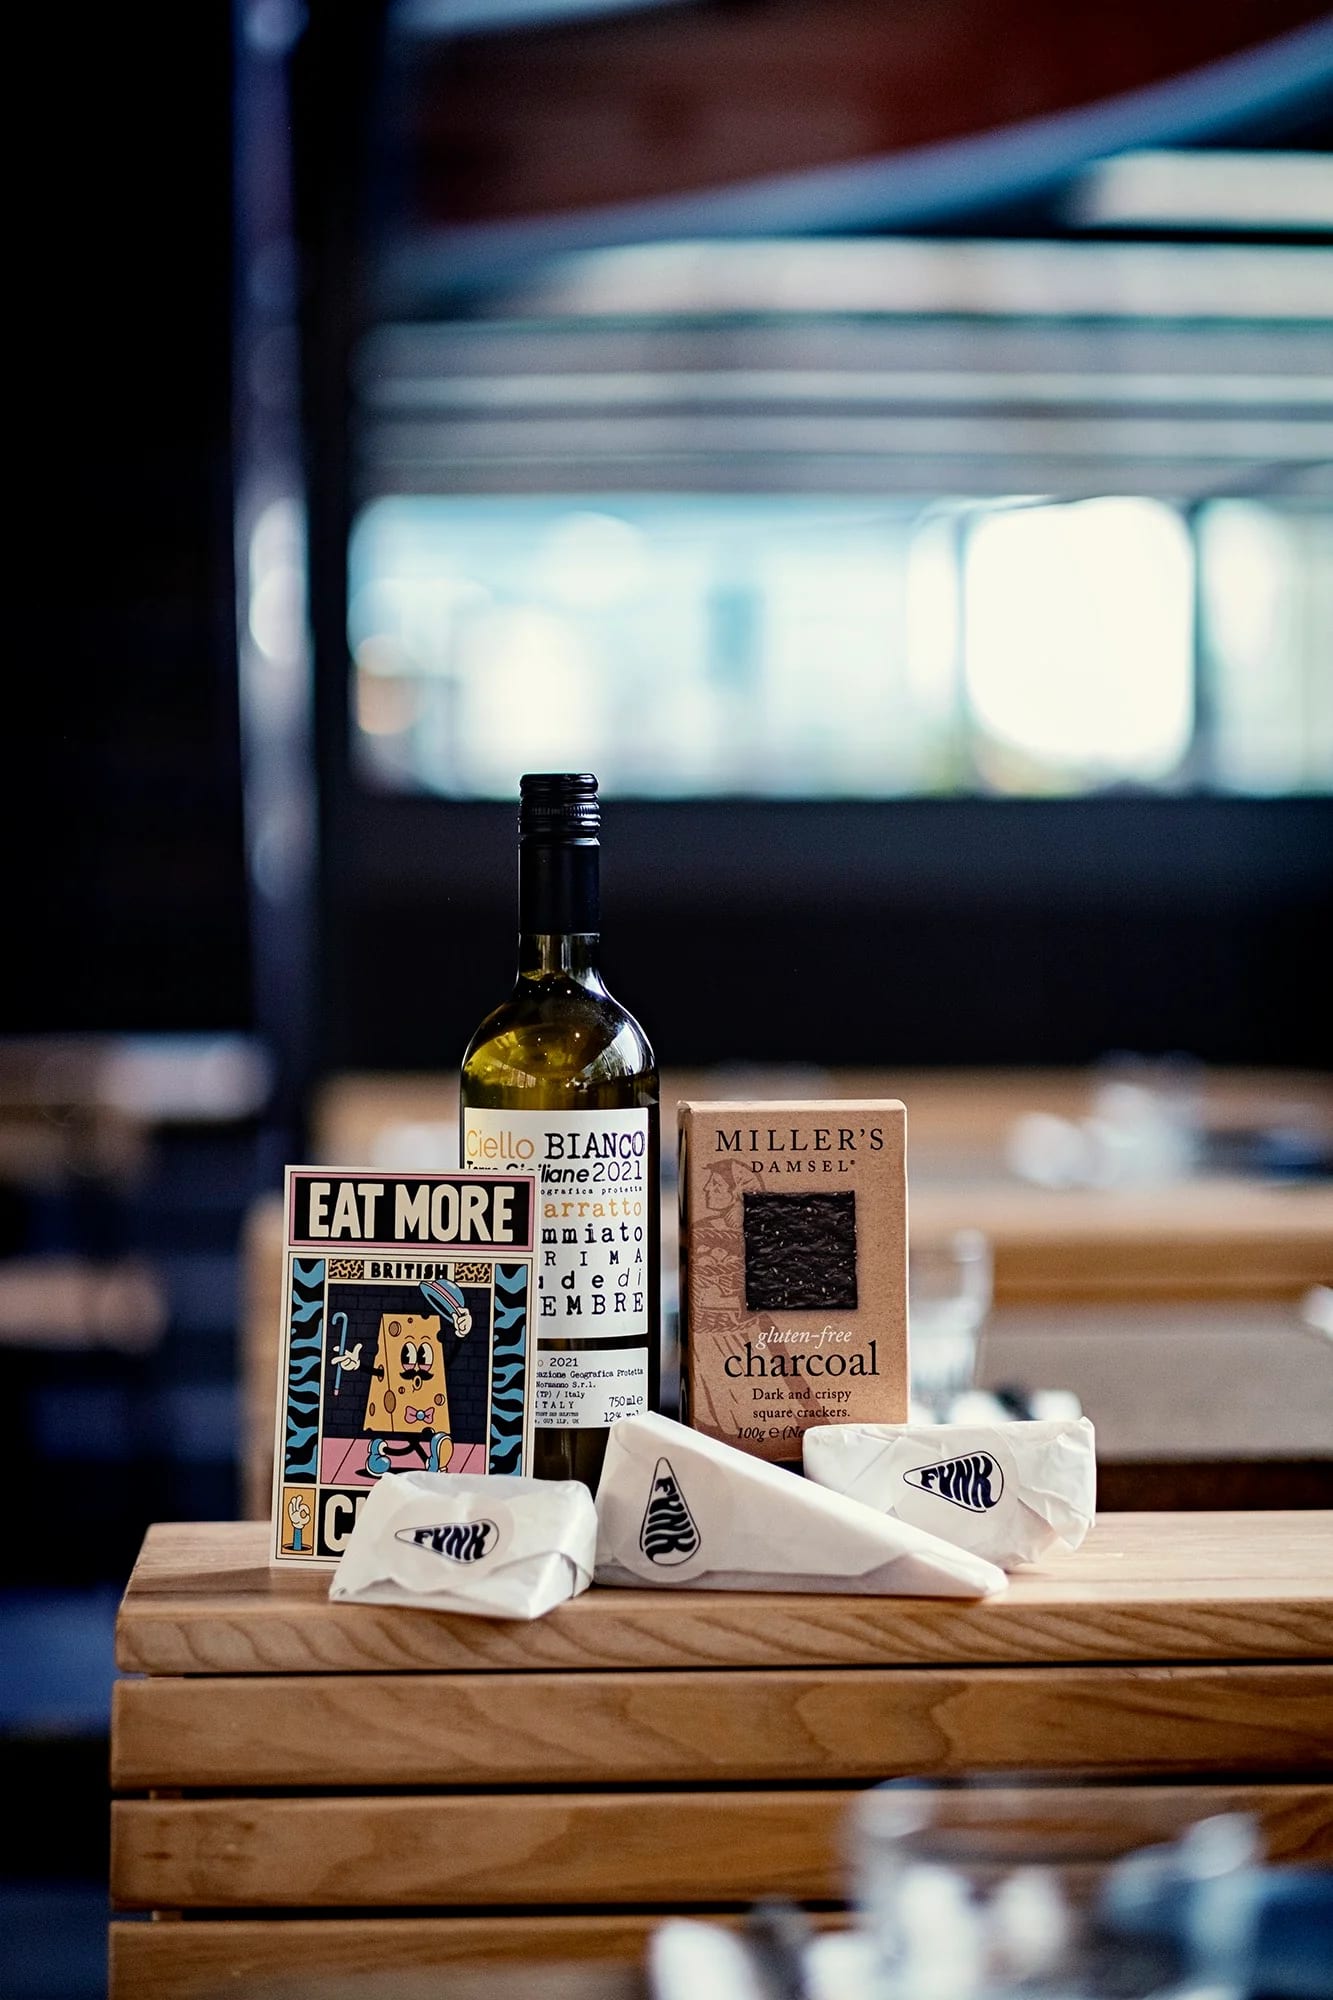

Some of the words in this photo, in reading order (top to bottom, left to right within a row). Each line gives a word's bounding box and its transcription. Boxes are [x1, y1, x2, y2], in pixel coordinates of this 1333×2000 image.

[466, 1129, 535, 1159] Ciello
[544, 1130, 645, 1160] BIANCO
[715, 1128, 884, 1152] MILLER'S
[593, 1160, 643, 1182] 2021
[540, 1187, 594, 1196] ografica
[309, 1182, 384, 1238] EAT
[394, 1184, 515, 1242] MORE
[544, 1197, 642, 1218] arratto
[541, 1221, 643, 1244] mmiato
[544, 1247, 643, 1267] RIMA
[370, 1262, 449, 1280] BRITISH
[540, 1292, 644, 1317] EMBRE
[755, 1325, 852, 1350] gluten-free
[550, 1357, 578, 1368] 2021
[724, 1340, 880, 1378] charcoal
[536, 1370, 567, 1379] azione
[752, 1388, 784, 1400] Dark
[788, 1388, 810, 1400] and
[815, 1388, 851, 1402] crispy
[752, 1407, 793, 1422] square
[797, 1406, 851, 1418] crackers.
[737, 1427, 766, 1442] 100g
